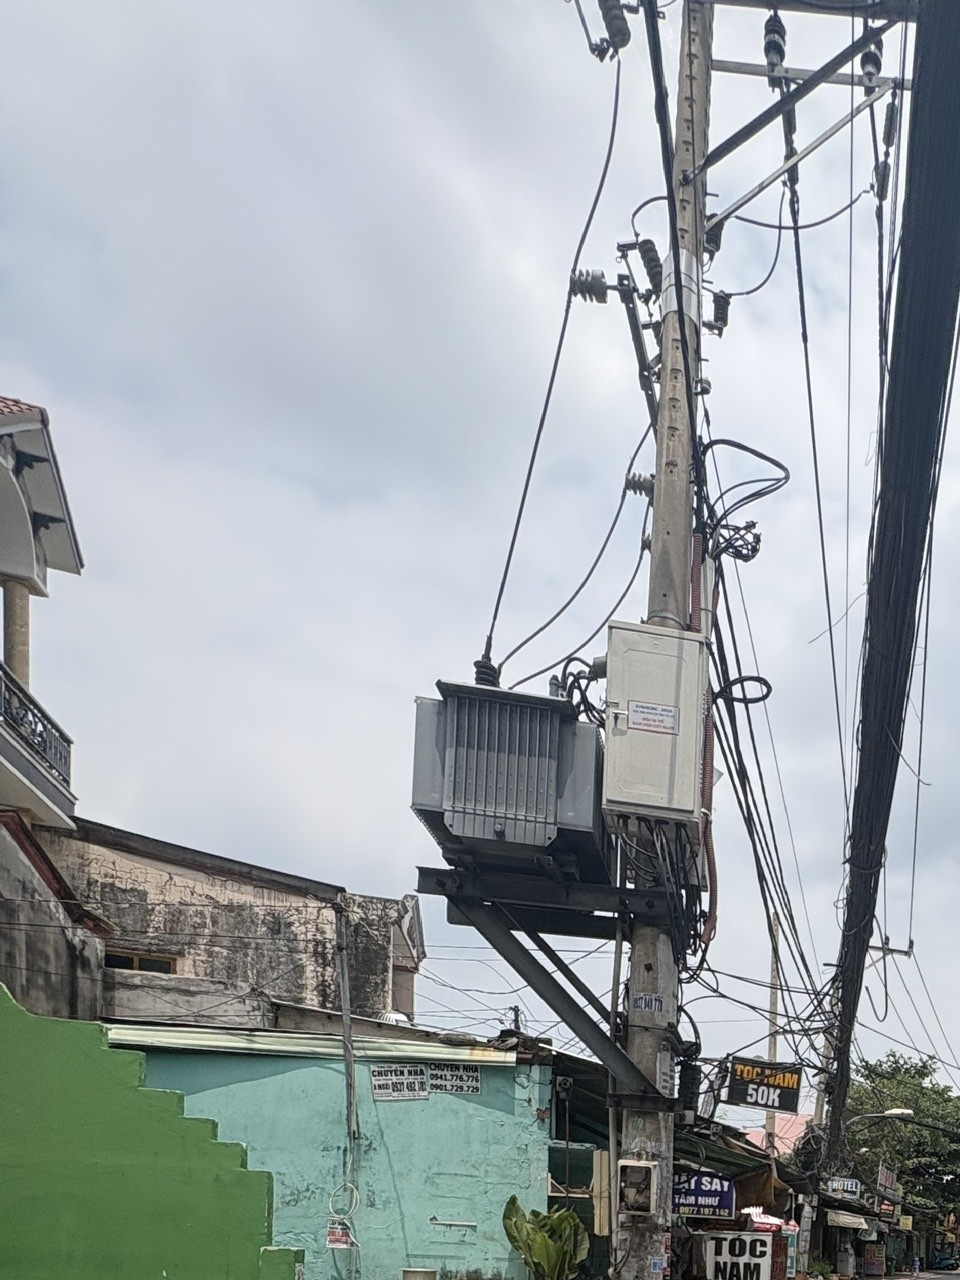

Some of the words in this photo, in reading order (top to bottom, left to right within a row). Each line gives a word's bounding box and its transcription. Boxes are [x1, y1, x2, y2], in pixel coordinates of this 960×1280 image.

[747, 1084, 781, 1106] 50K
[833, 1180, 857, 1191] HOTEL
[710, 1234, 767, 1258] TÓC
